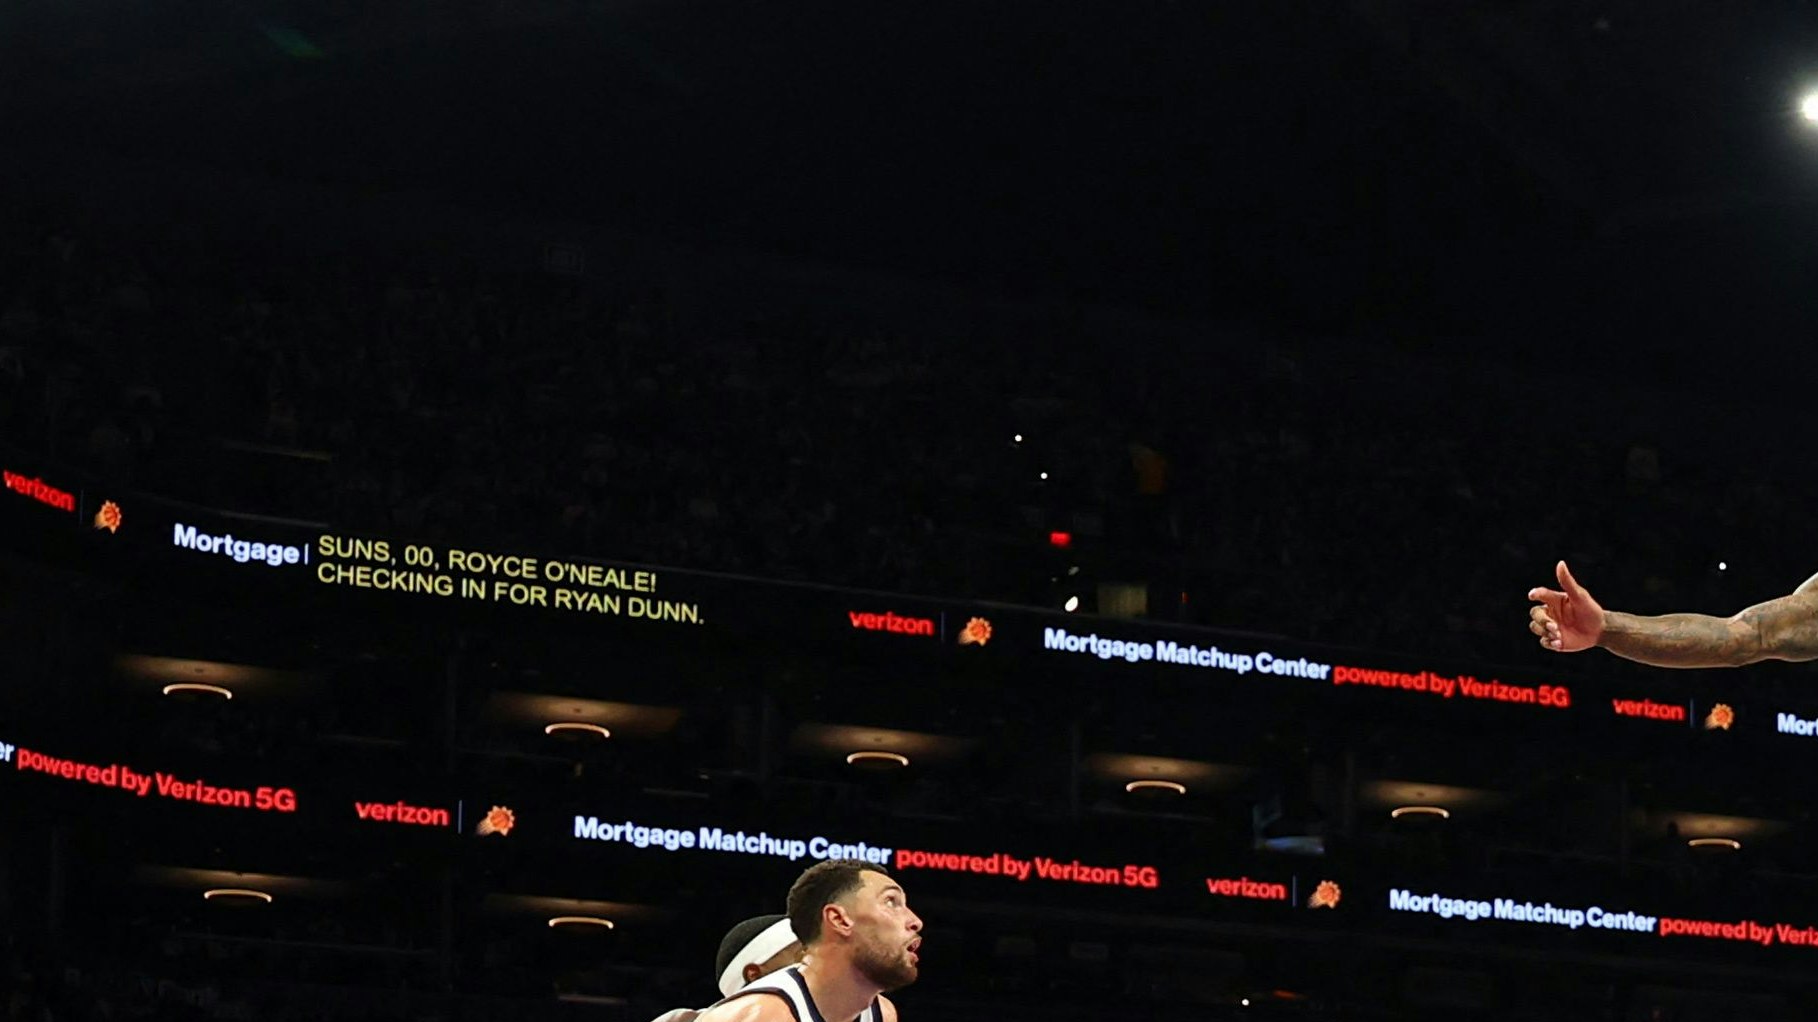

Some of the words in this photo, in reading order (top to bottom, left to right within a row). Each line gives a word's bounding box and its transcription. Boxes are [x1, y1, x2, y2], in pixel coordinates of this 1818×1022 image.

[3, 469, 75, 511] verizon
[173, 523, 301, 566] Mortgage
[318, 535, 396, 566] SUNS,
[404, 545, 439, 570] 00,
[449, 550, 537, 579] ROYCE
[545, 561, 656, 592] O'NEALE!
[317, 563, 453, 596] CHECKING
[462, 579, 486, 600] IN
[495, 582, 546, 607] FOR
[555, 589, 620, 615] RYAN
[628, 598, 704, 624] DUNN.
[849, 611, 934, 636] verizon
[1044, 627, 1154, 663] Mortgage
[1156, 640, 1254, 675] Matchup
[1255, 651, 1331, 680] Center
[1333, 664, 1426, 692] powered
[1429, 672, 1456, 698] by
[1458, 675, 1535, 703] Verizon
[1537, 685, 1570, 707] 5G
[1613, 698, 1684, 721] verizon
[17, 748, 117, 786] powered
[120, 765, 151, 796] by
[155, 772, 251, 808] Verizon
[255, 786, 296, 812] 5G
[355, 801, 449, 826] verizon
[574, 815, 695, 851] Mortgage
[698, 826, 807, 861] Matchup
[808, 836, 893, 865] Center
[895, 848, 997, 875] powered
[1001, 853, 1031, 881] by
[1034, 857, 1120, 885] Verizon
[1122, 865, 1158, 888] 5G
[1207, 876, 1286, 899] verizon
[1389, 889, 1492, 921] Mortgage
[1494, 898, 1585, 930] Matchup
[1586, 906, 1657, 933] Center
[1659, 916, 1747, 942] powered
[1748, 920, 1774, 945] by
